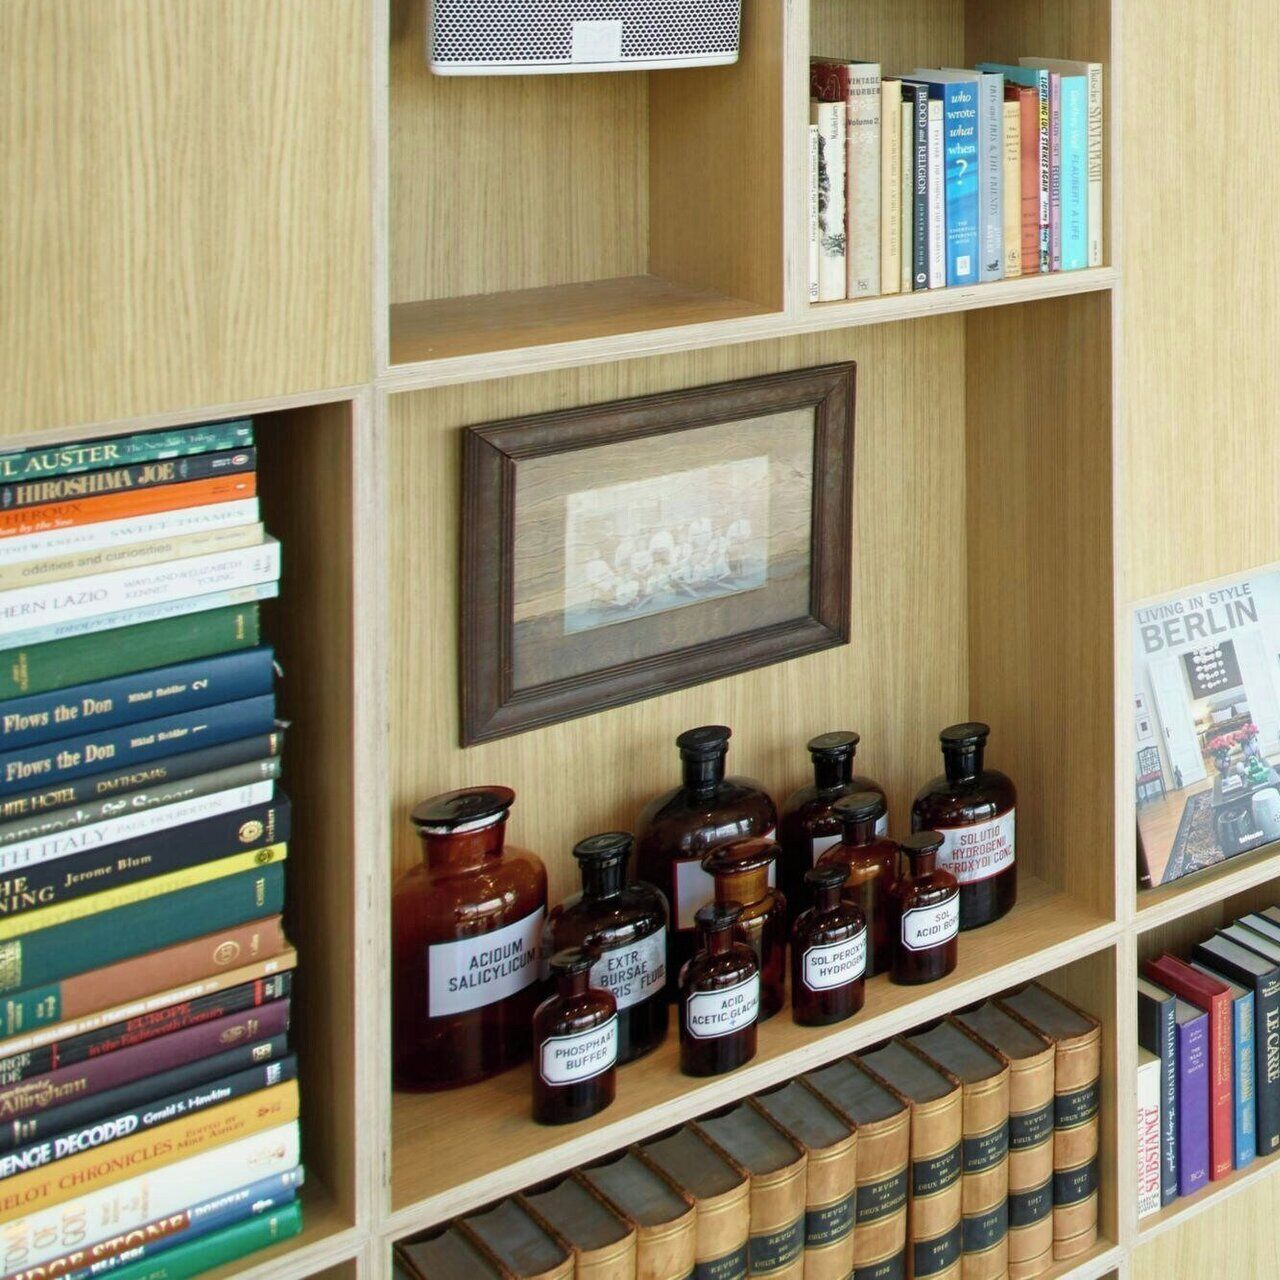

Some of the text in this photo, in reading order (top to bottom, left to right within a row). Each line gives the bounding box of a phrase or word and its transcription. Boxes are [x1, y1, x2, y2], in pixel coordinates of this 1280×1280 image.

[918, 92, 927, 128] BLOOD
[950, 92, 972, 104] who
[1040, 77, 1048, 116] LIGHTNING
[947, 108, 975, 119] wrote
[1040, 118, 1048, 136] LUCY
[918, 130, 926, 143] and
[949, 124, 974, 136] what
[948, 143, 975, 154] when
[917, 145, 927, 195] RELIGION
[24, 444, 121, 470] AUSTER
[16, 462, 175, 506] HIROSHIMA JOE
[22, 543, 172, 576] oddities and curiosities
[53, 590, 108, 610] LAZIO
[1136, 582, 1252, 625] LIVING IN STYLE
[1139, 596, 1258, 655] BERLIN
[3, 712, 49, 734] Flows
[54, 703, 78, 721] the
[83, 697, 113, 715] Don
[6, 759, 51, 782] Flows
[57, 751, 81, 769] the
[85, 744, 115, 763] Don
[41, 826, 107, 857] ITALY
[960, 825, 1000, 846] SOLUTIO
[64, 854, 152, 888] Jerome Blum
[916, 924, 941, 939] ACIDI
[448, 947, 537, 993] SALICYLICUM
[469, 938, 523, 971] ACIDUM
[607, 950, 642, 972] EXTR.
[600, 962, 648, 987] BURSAE
[721, 994, 744, 1011] ACID
[1266, 1007, 1279, 1028] LE
[555, 1030, 615, 1060] PHOSPHAAT
[1167, 1009, 1176, 1058] WILLIAM
[566, 1048, 607, 1071] BUFFER
[54, 1114, 138, 1157] DECODED
[189, 1087, 231, 1108] Hawkins
[1145, 1105, 1160, 1192] SUBSTANCE
[58, 1139, 173, 1190] CHRONICLES
